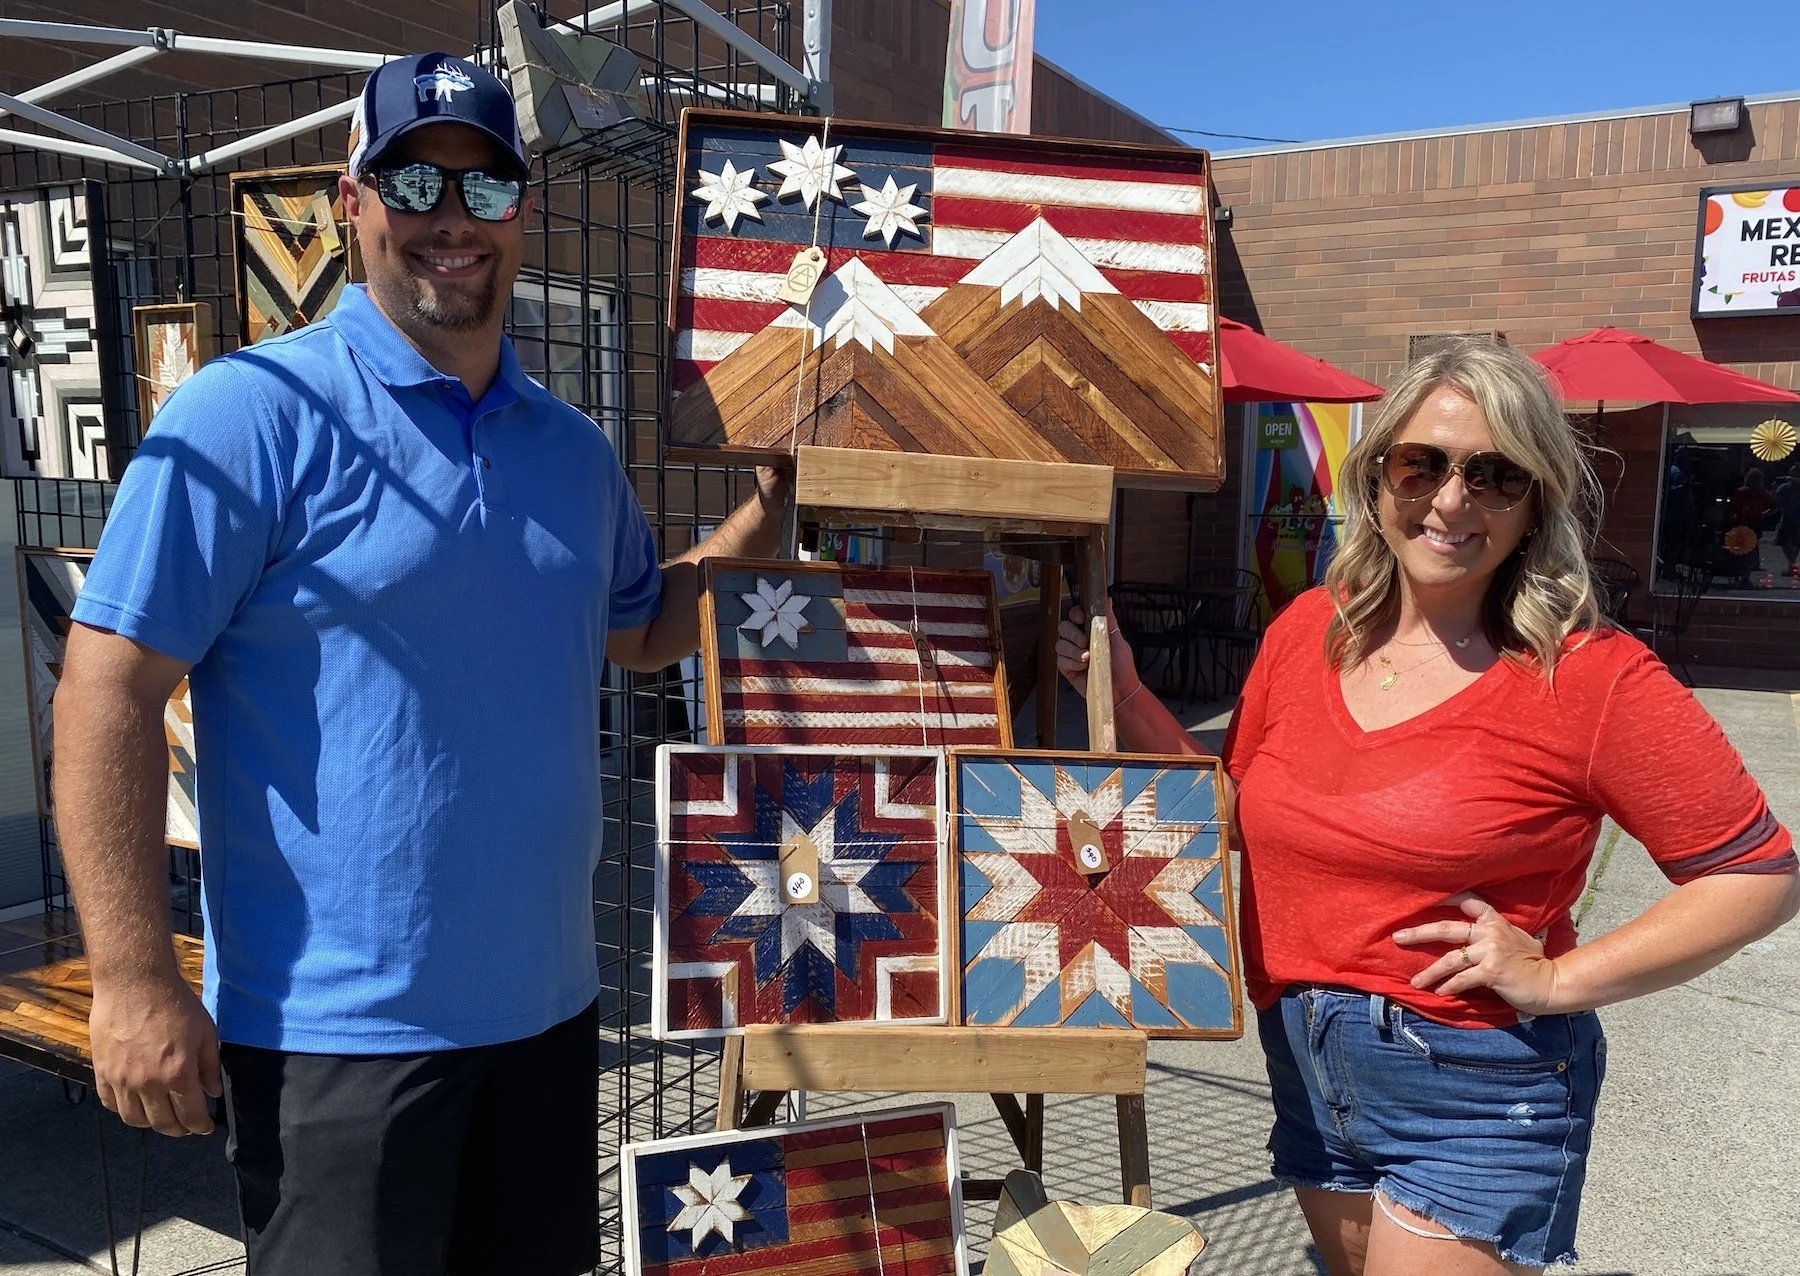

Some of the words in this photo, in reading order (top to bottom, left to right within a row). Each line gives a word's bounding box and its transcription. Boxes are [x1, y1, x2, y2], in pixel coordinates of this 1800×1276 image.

[1740, 217, 1800, 241] MEX
[1770, 244, 1800, 266] RE
[1742, 271, 1796, 283] FRUTAS
[1265, 423, 1292, 436] OPEN
[792, 877, 805, 894] $40
